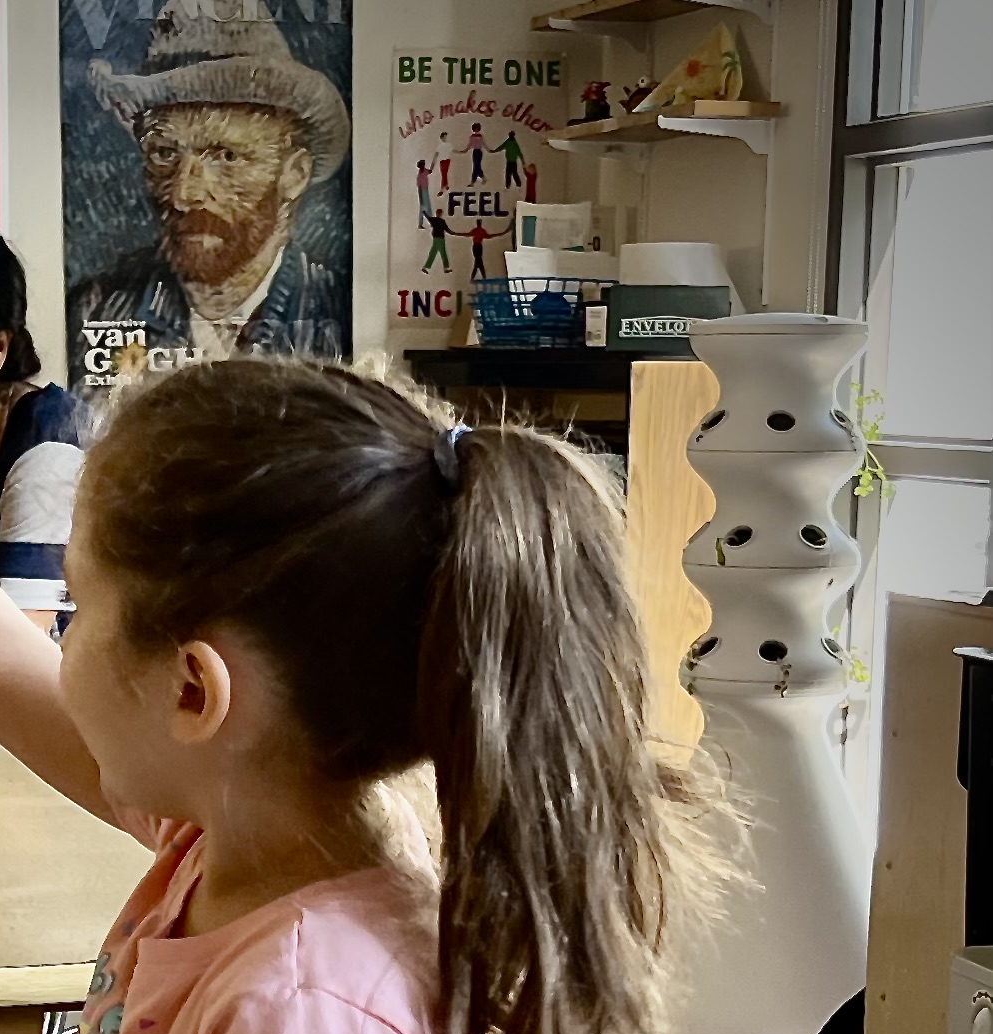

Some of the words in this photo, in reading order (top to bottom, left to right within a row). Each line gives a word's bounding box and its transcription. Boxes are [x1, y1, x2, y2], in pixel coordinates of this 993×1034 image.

[398, 56, 432, 83] BE
[443, 57, 493, 85] THE
[504, 59, 561, 87] ONE
[398, 108, 434, 139] who
[439, 89, 497, 119] makes
[501, 101, 555, 133] other
[447, 191, 509, 217] FEEL
[81, 328, 146, 347] van
